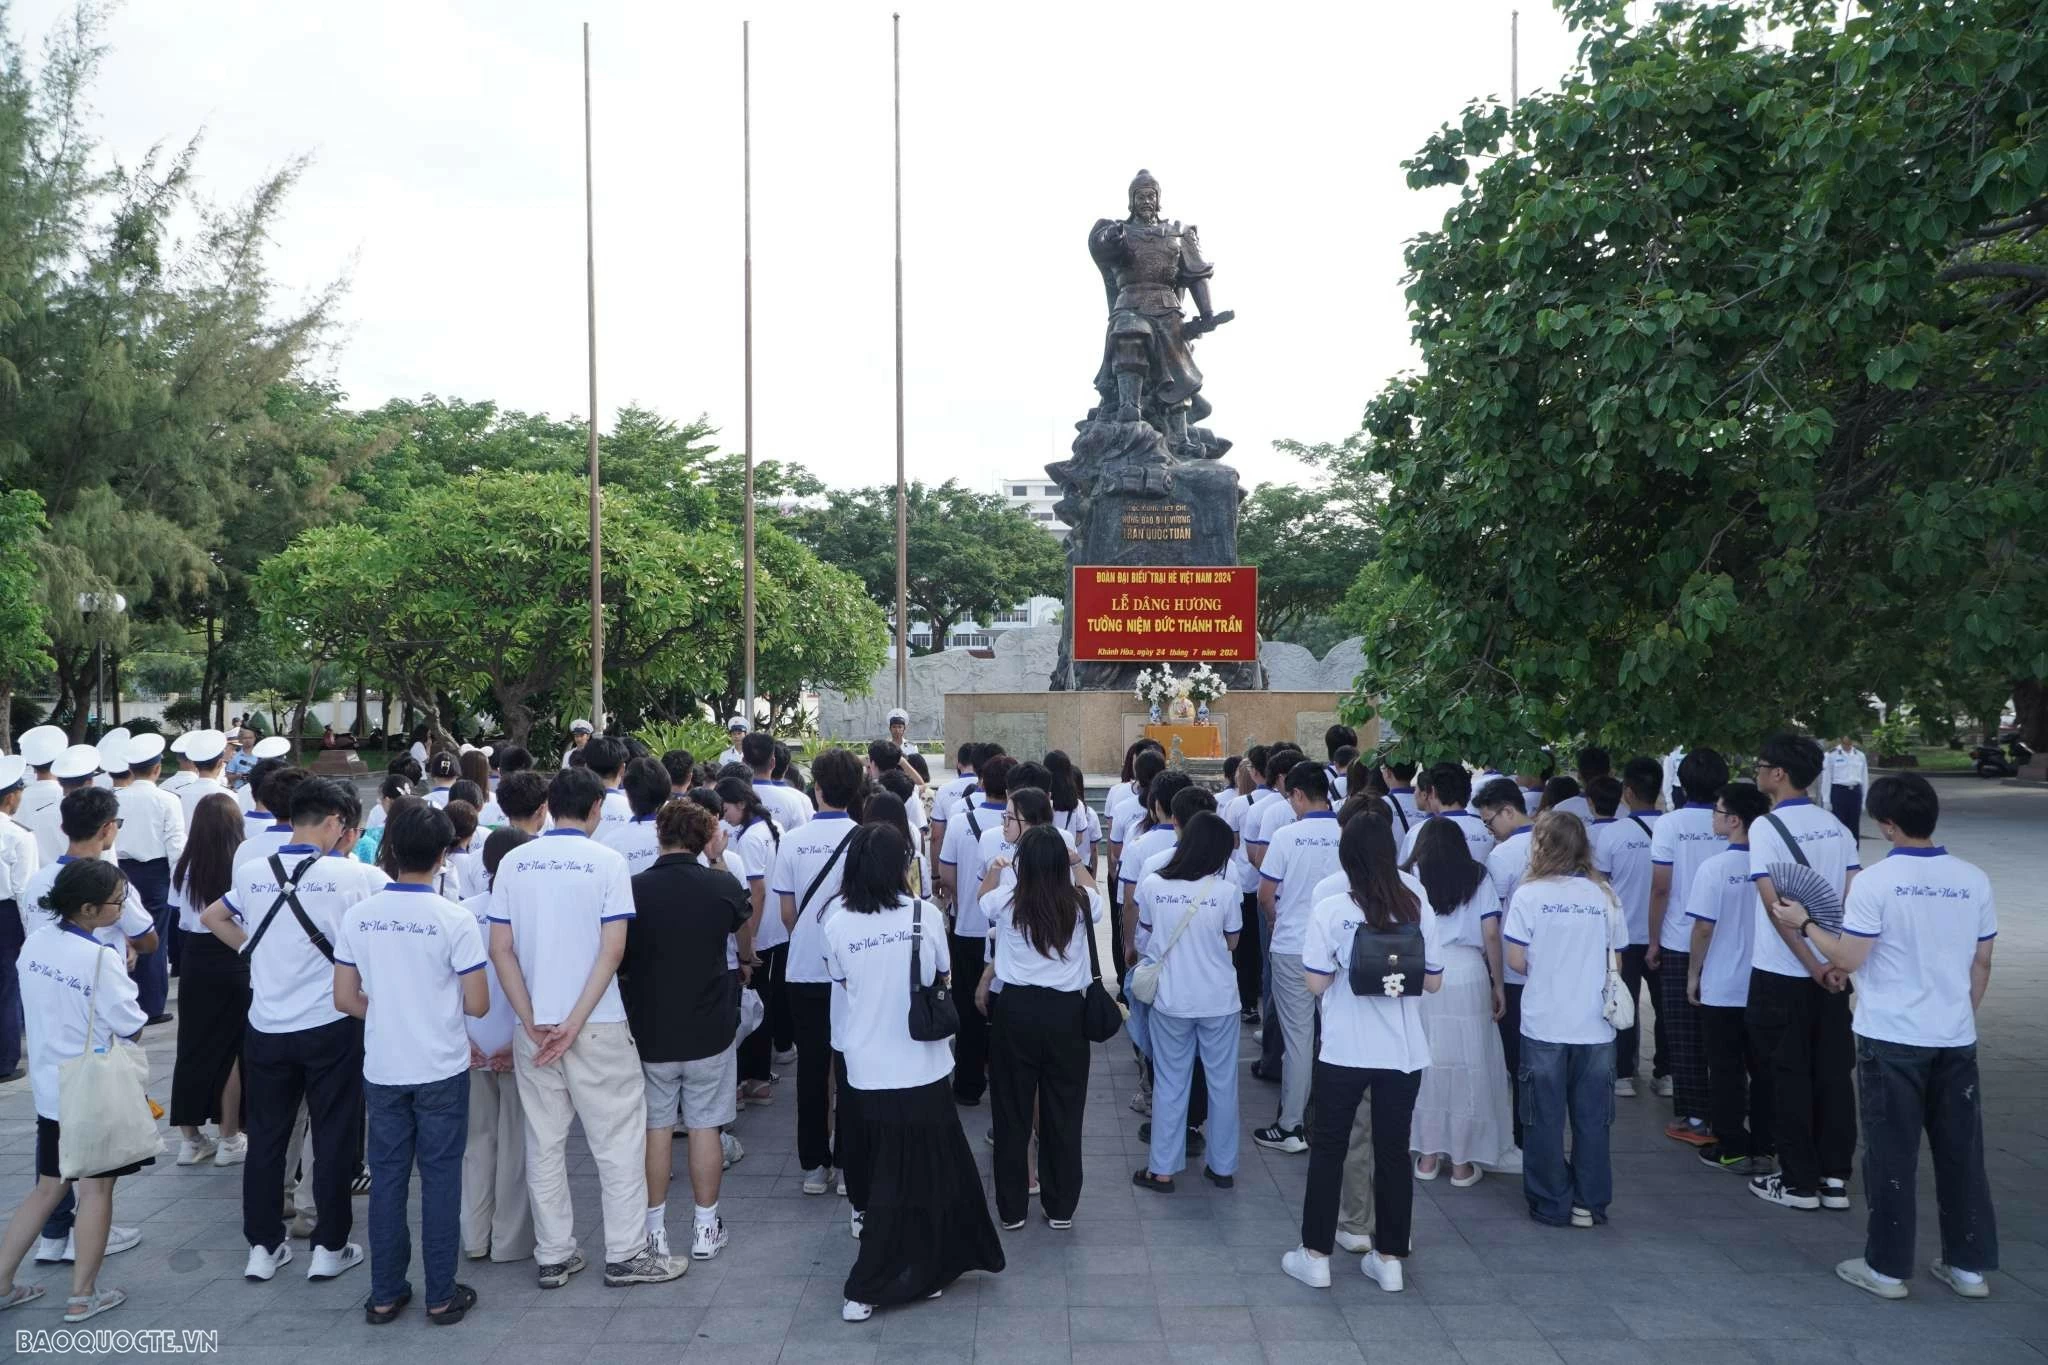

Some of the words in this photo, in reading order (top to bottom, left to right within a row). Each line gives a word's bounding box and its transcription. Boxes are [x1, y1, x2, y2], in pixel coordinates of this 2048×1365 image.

[1096, 570, 1115, 583] ĐOÀN
[1118, 572, 1129, 584] ĐẠI
[1168, 570, 1177, 583] HÈ
[1180, 570, 1193, 584] VIỆT
[1196, 572, 1212, 583] NAM
[1112, 593, 1129, 611] LỄ
[1134, 596, 1170, 611] DÂNG
[1174, 597, 1222, 611] HƯƠNG
[1127, 616, 1150, 635] NIỆM
[1155, 616, 1175, 632] ĐỨC
[1178, 616, 1212, 632] THÁNH
[1214, 614, 1243, 632] TRẦN
[1098, 647, 1118, 656] Khánh
[1137, 648, 1153, 657] ngày
[1170, 648, 1188, 657] tháng
